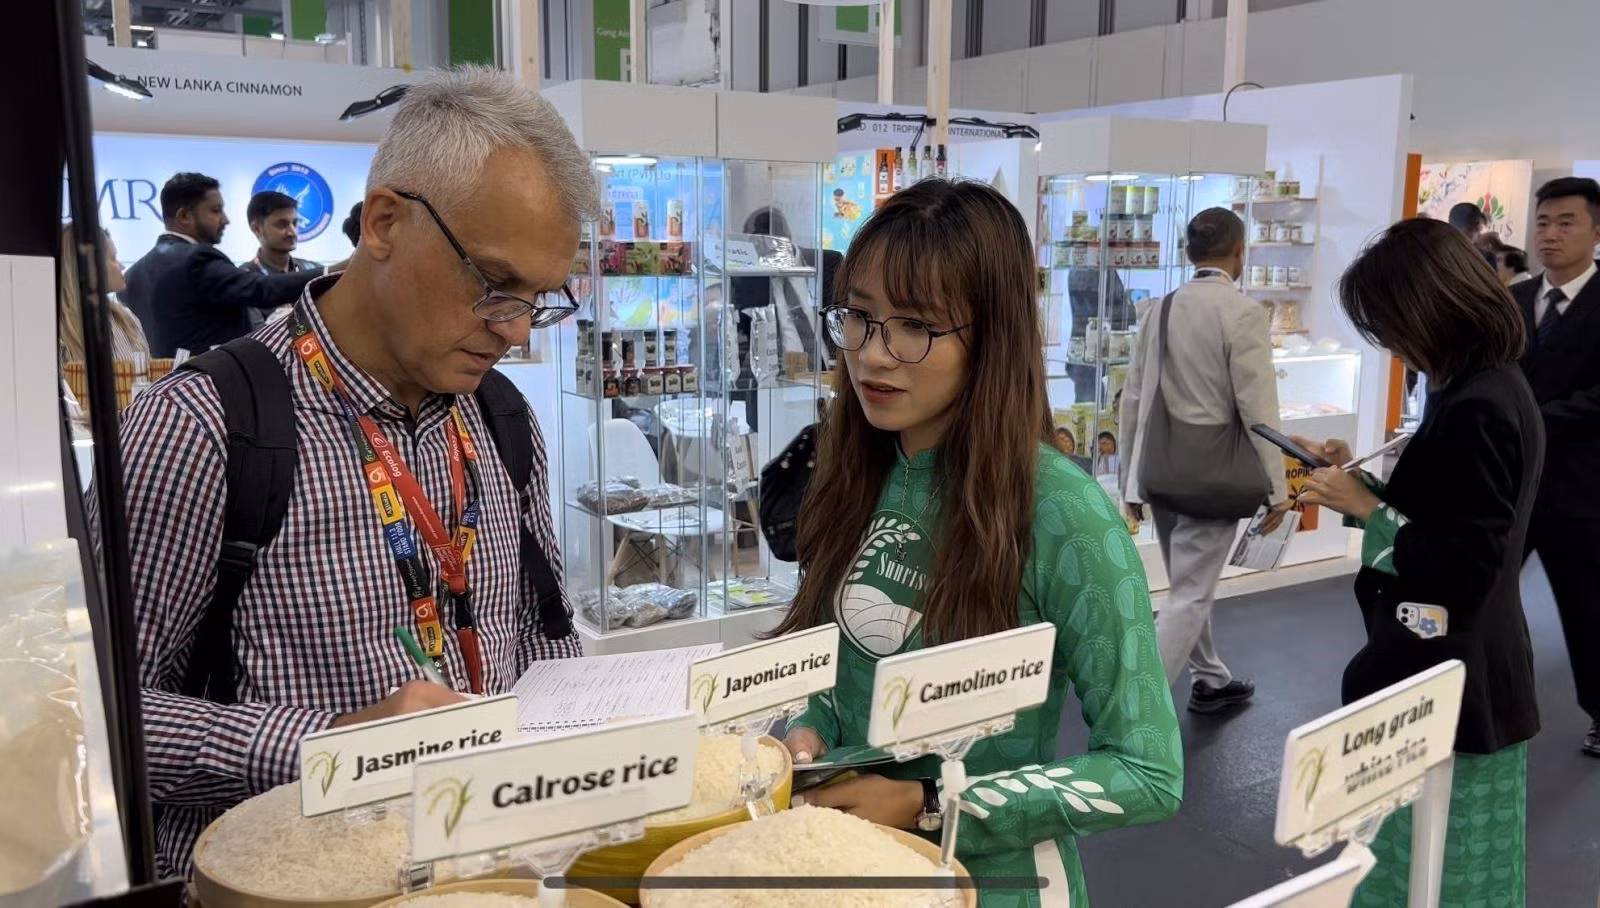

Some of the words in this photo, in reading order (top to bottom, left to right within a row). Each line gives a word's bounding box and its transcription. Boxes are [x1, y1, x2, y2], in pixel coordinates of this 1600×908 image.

[137, 75, 170, 89] NEW
[174, 78, 222, 93] LANKA
[226, 81, 302, 97] CINNAMON
[872, 123, 888, 132] 012
[450, 435, 460, 462] Ecolog
[382, 449, 402, 478] Ecolog
[393, 540, 404, 555] HALL
[400, 537, 411, 555] STAND
[722, 663, 798, 698] Japonica
[801, 651, 832, 673] rice
[919, 668, 1007, 704] Camolino
[1010, 658, 1045, 682] rice
[1342, 720, 1386, 757] Long
[1389, 696, 1434, 739] grain
[352, 740, 454, 781] Jasmine
[459, 729, 502, 749] rice
[491, 766, 616, 809] Calrose
[621, 754, 679, 784] rice
